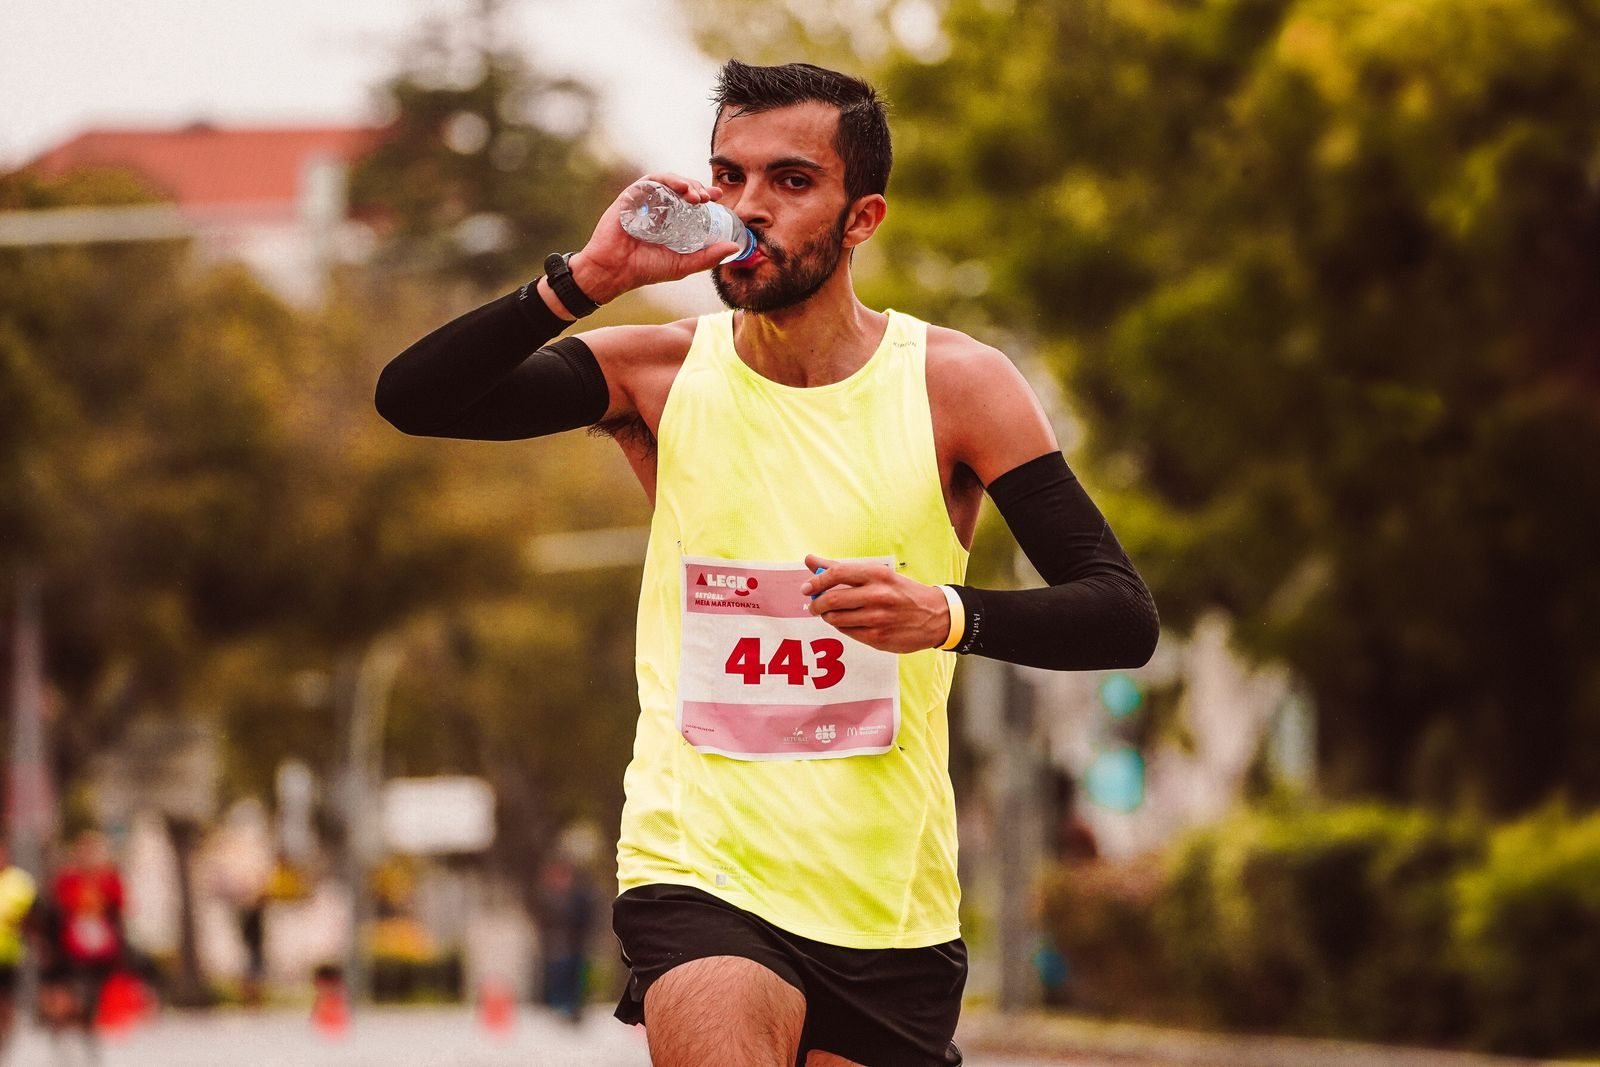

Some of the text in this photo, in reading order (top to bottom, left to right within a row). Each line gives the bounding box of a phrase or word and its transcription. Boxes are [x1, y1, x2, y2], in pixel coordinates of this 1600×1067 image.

[696, 572, 759, 591] ALEGRO
[694, 599, 711, 607] MEIA
[725, 637, 846, 690] 443
